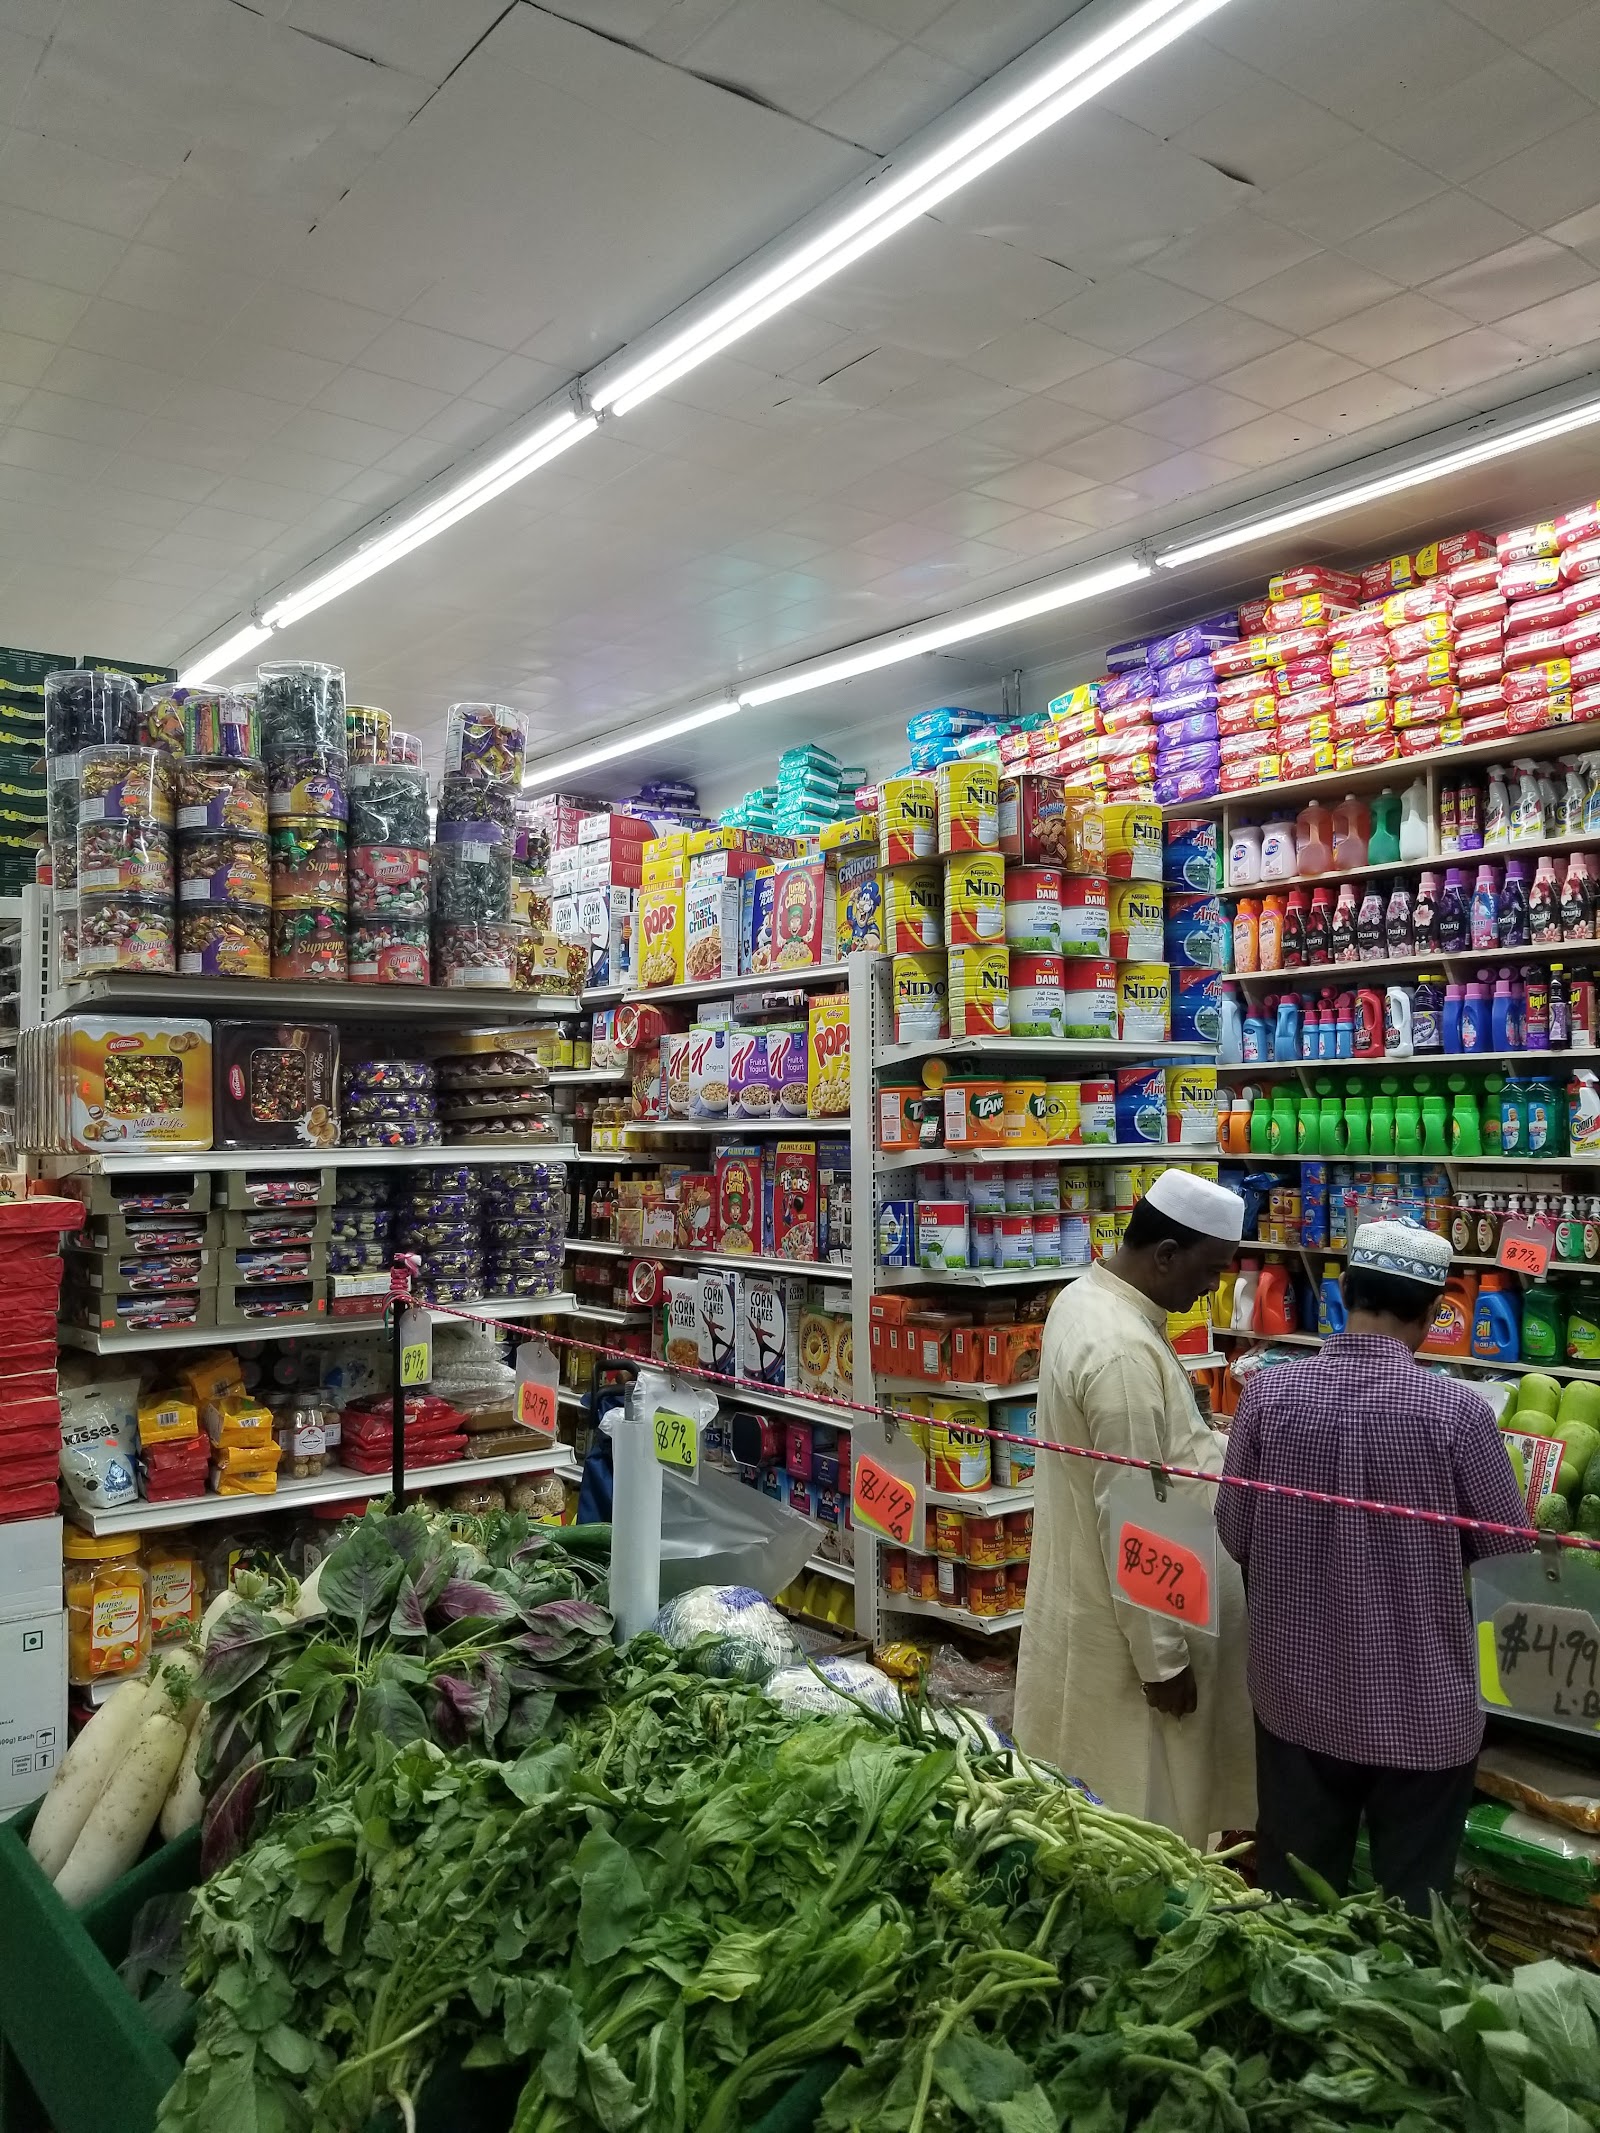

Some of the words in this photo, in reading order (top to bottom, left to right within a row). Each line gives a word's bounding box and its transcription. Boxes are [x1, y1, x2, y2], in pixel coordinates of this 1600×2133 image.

[1439, 535, 1467, 550] HUGGIES
[1362, 564, 1390, 580] HUGGIES
[1240, 603, 1267, 616] HUGGIES
[1271, 602, 1302, 614] HUGGIES
[1510, 671, 1542, 684] HUGGIES
[1281, 722, 1310, 735] HUGGIES
[1406, 728, 1439, 740] HUGGIES
[1226, 763, 1254, 774] HUGGIES
[838, 855, 878, 884] CRUNCH
[644, 882, 662, 892] FAMILY
[663, 880, 676, 888] SIZE
[788, 882, 806, 895] Lucky
[784, 893, 807, 909] Charms
[1037, 890, 1058, 899] DANO
[1085, 895, 1105, 905] DANO
[584, 902, 600, 915] CORN
[688, 894, 718, 912] Cinnamon
[556, 908, 572, 922] CORN
[693, 904, 712, 922] Toast
[1530, 912, 1550, 921] Downy
[1561, 909, 1582, 918] Downy
[643, 905, 676, 946] POPS
[689, 911, 718, 934] Crunch
[1440, 922, 1460, 930] Downy
[1498, 917, 1517, 925] Downy
[1358, 931, 1379, 940] Downy
[1388, 927, 1407, 936] Downy
[299, 938, 345, 955] Supreme
[1036, 974, 1058, 984] DANO
[1096, 978, 1115, 988] DANO
[898, 980, 946, 996] NIDO
[1123, 984, 1168, 1000] NIDO
[815, 996, 839, 1006] FAMILY
[1529, 993, 1547, 1009] Raid
[110, 1040, 140, 1050] Wellmade
[670, 1041, 689, 1079] K
[692, 1036, 712, 1076] K
[731, 1040, 755, 1080] K
[770, 1038, 790, 1079] K
[313, 1053, 324, 1080] Toffee
[749, 1066, 767, 1074] Yogurt
[787, 1064, 804, 1073] Yogurt
[976, 1096, 1004, 1116] TANG
[133, 1117, 155, 1128] Milk
[157, 1117, 187, 1129] Toffee
[1576, 1115, 1594, 1134] SHOUT
[728, 1170, 744, 1184] Lucky
[726, 1181, 745, 1195] Charms
[783, 1178, 809, 1193] LOOPS
[703, 1287, 724, 1302] CORN
[750, 1292, 773, 1308] CORN
[674, 1302, 696, 1315] CORN
[703, 1301, 724, 1315] FLAKES
[750, 1306, 773, 1322] FLAKES
[674, 1314, 696, 1328] FLAKES
[1477, 1321, 1490, 1337] all
[803, 1326, 812, 1348] HONEY
[813, 1324, 828, 1353] BUNCHES
[839, 1334, 848, 1357] HONEY
[808, 1361, 820, 1370] OATS
[524, 1390, 547, 1417] $2.99
[1538, 1462, 1546, 1476] TOWN
[1124, 1538, 1184, 1588] $3.99
[96, 1600, 123, 1610] Mango
[1166, 1593, 1185, 1610] LB
[107, 1605, 132, 1613] Coconut
[806, 1640, 822, 1648] KEEP
[1498, 1612, 1598, 1688] $4.99
[18, 1733, 35, 1741] Each
